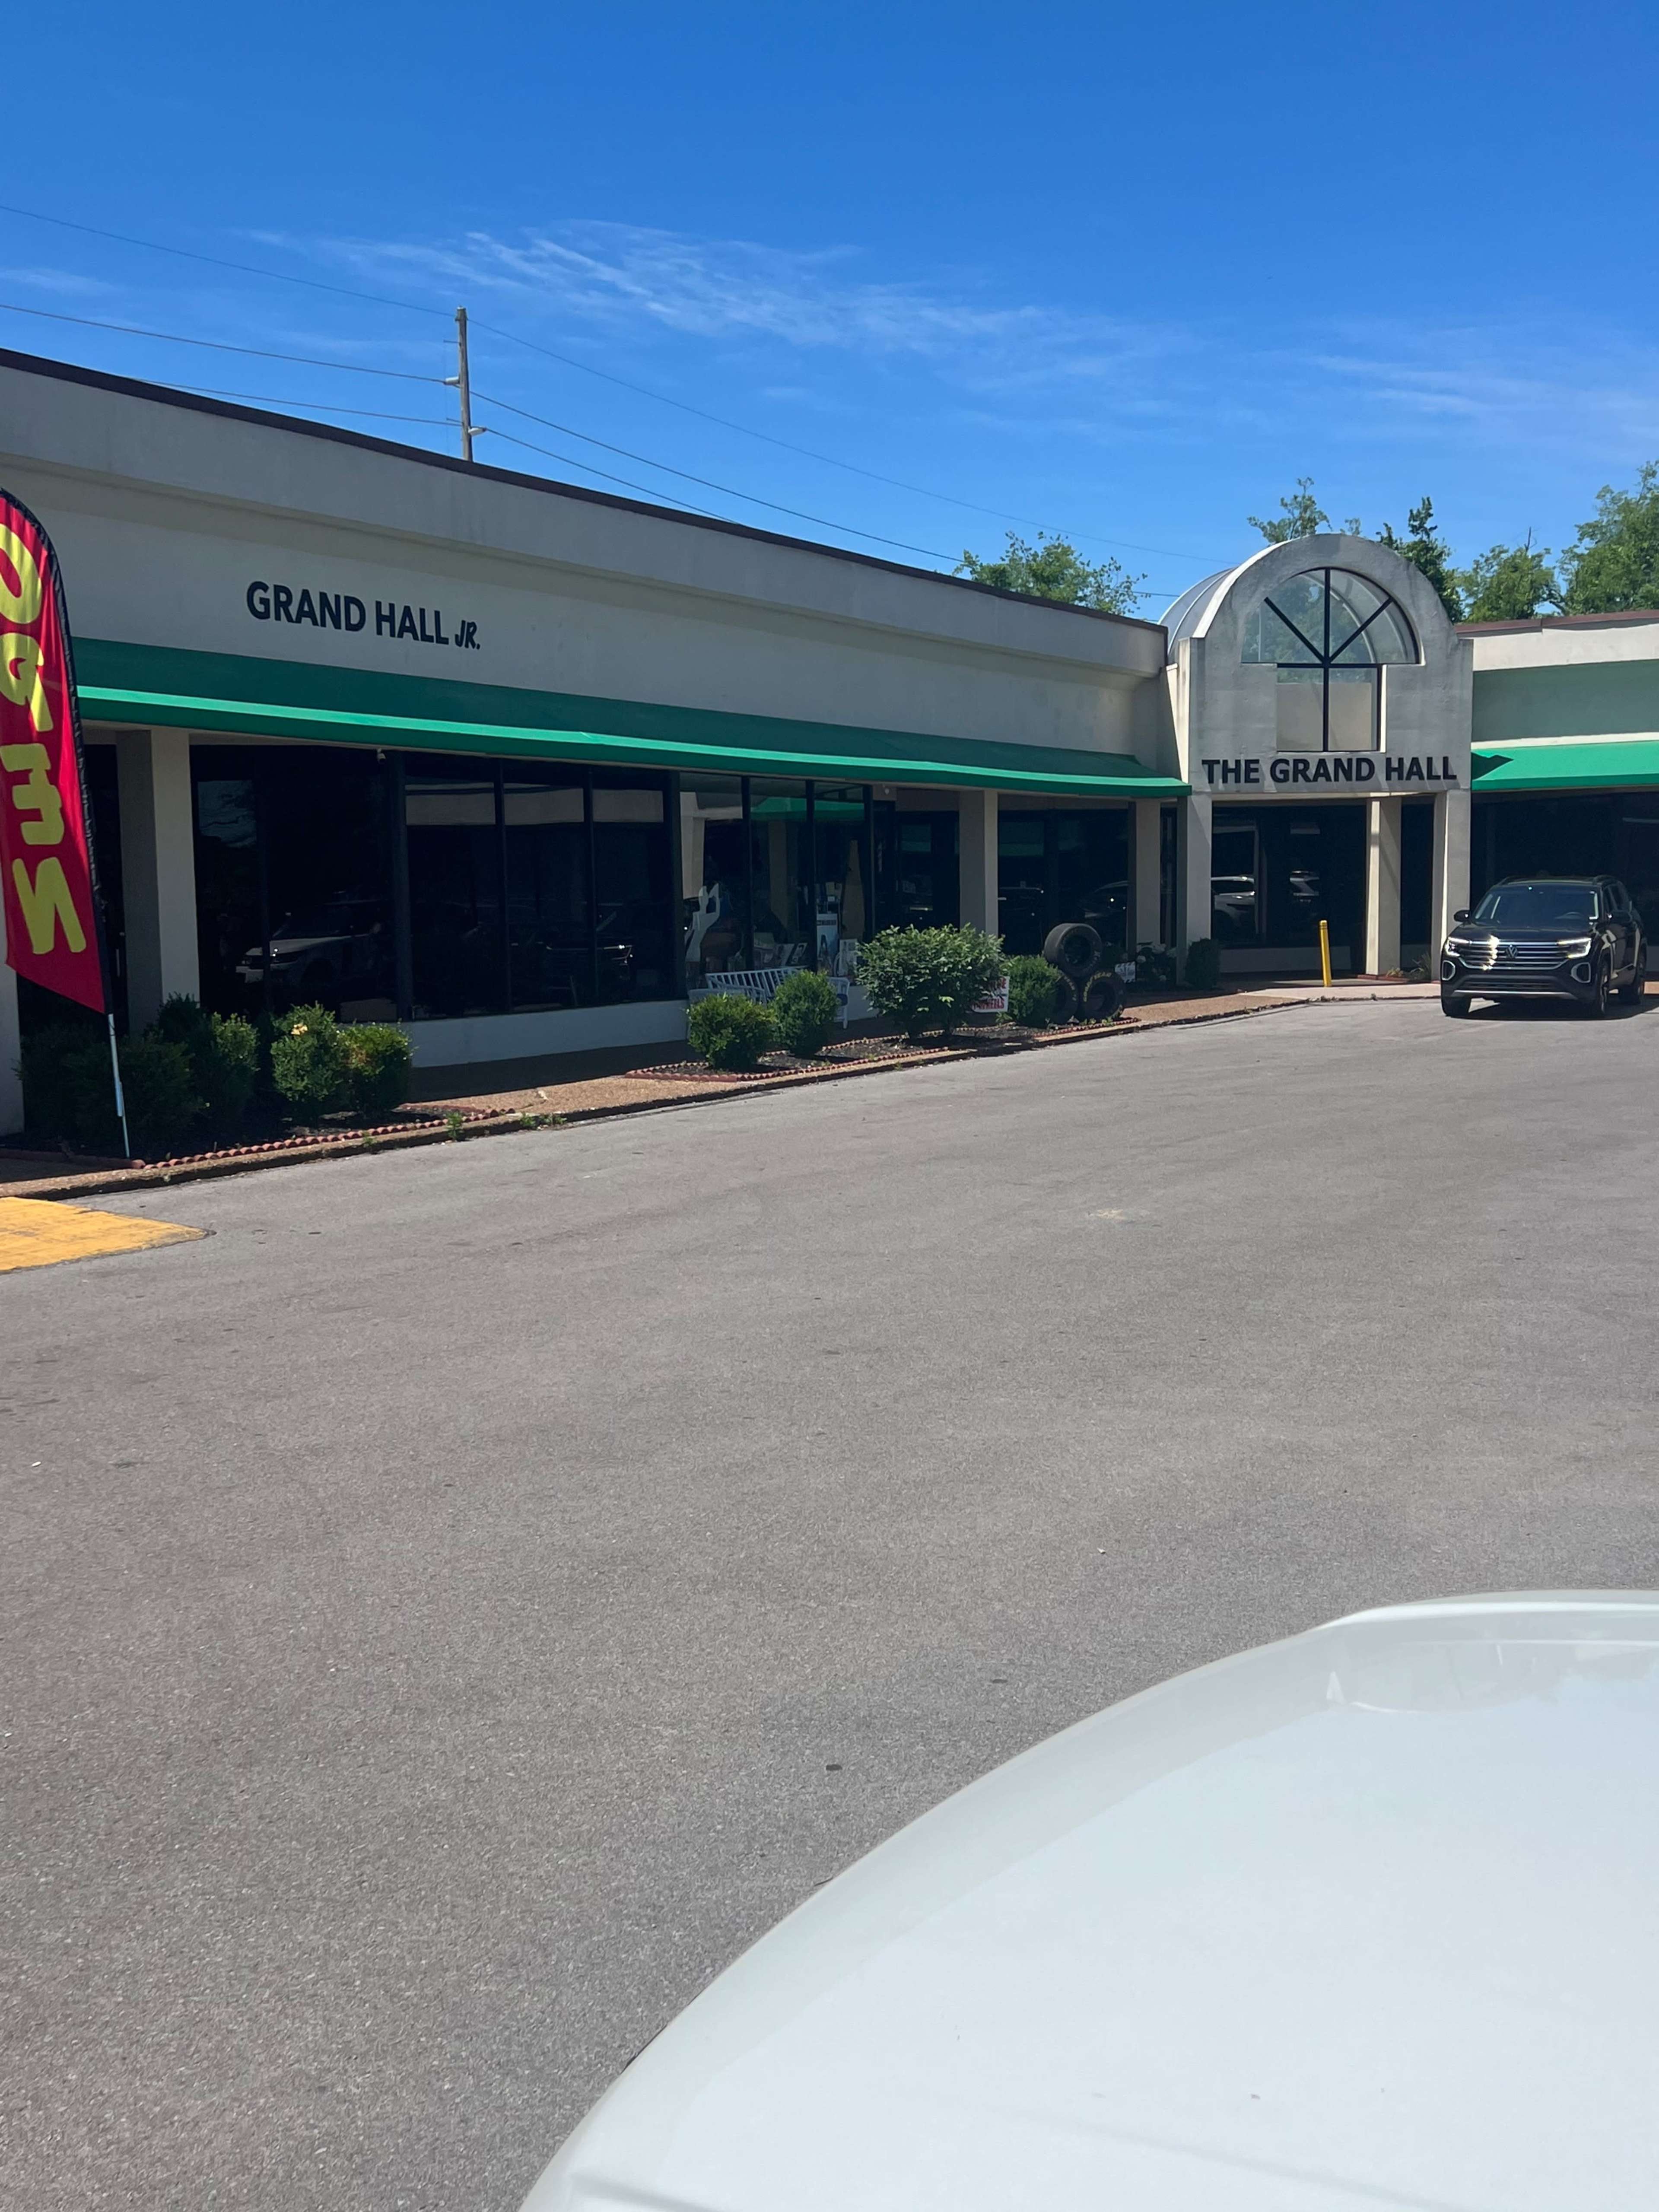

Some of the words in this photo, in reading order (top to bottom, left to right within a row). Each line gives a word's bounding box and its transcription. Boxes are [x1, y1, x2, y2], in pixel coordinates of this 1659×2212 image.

[247, 581, 366, 632] GRAND
[375, 600, 449, 645] HALL
[454, 620, 481, 649] JR.
[1202, 759, 1260, 784] THE
[1270, 758, 1375, 783] GRAND
[1386, 756, 1457, 781] HALL
